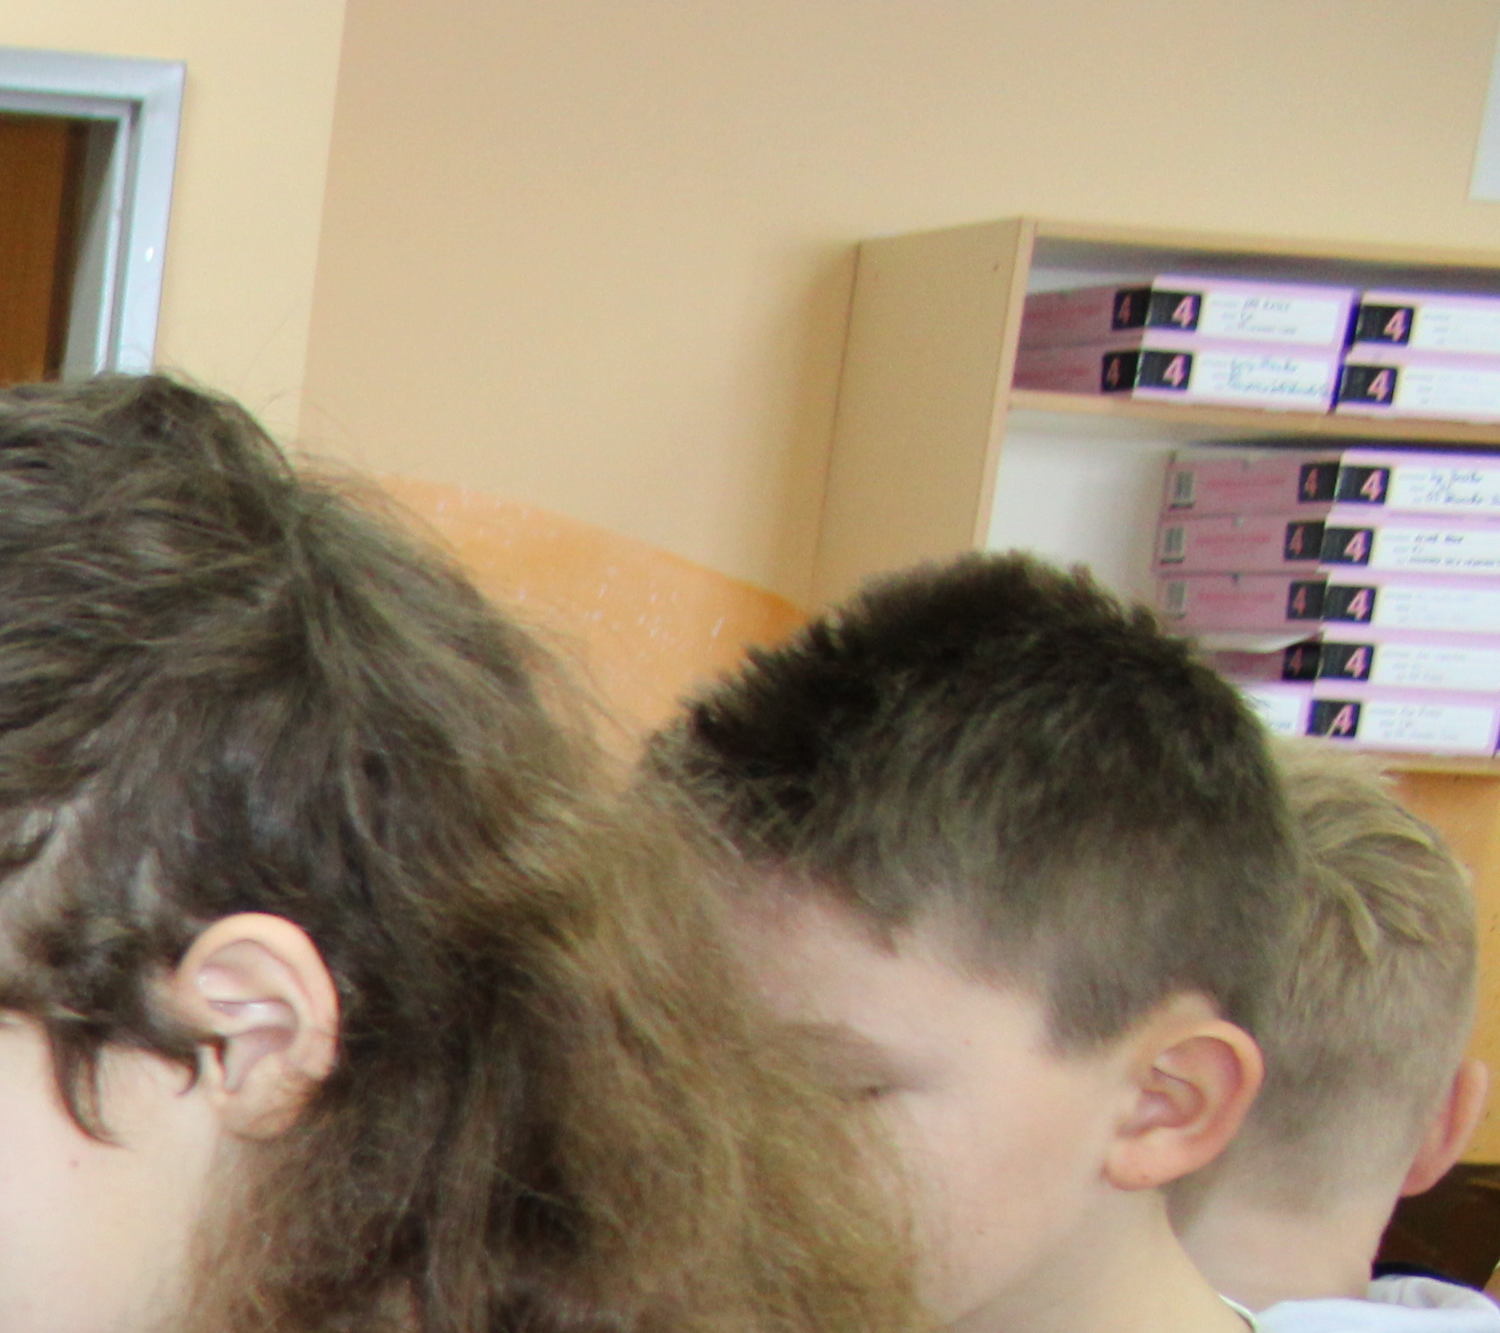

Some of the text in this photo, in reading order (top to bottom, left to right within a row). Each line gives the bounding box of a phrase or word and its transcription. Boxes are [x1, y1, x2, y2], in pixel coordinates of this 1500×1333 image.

[1171, 295, 1196, 328] 4
[1383, 306, 1409, 342] 4
[1162, 354, 1187, 388] 4
[1367, 369, 1391, 403] 4
[1360, 469, 1384, 501] 4
[1344, 531, 1368, 563] 4
[1347, 588, 1369, 620] 4
[1344, 647, 1367, 678] 4
